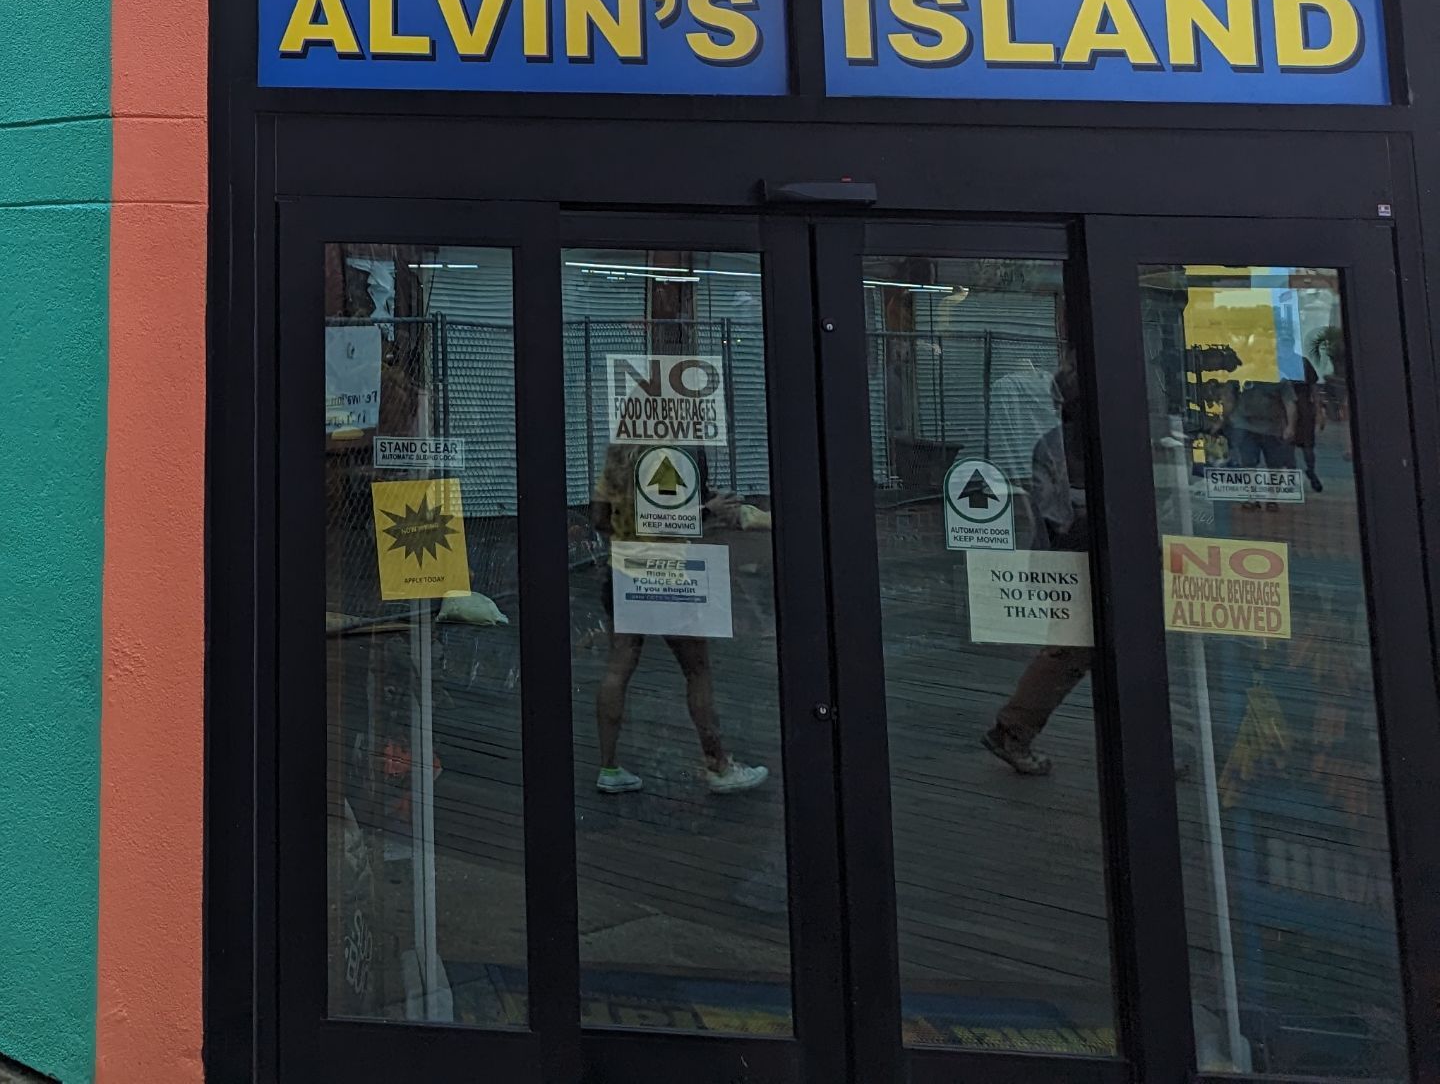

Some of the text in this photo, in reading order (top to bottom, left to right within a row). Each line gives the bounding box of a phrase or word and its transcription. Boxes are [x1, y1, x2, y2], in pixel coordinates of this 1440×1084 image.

[613, 359, 720, 398] NO
[614, 397, 717, 421] FOOD OR BEVERAGES
[616, 420, 719, 439] ALLOWED
[380, 441, 458, 454] STAND CLEAR
[1210, 472, 1295, 486] STAND CLEAR
[640, 513, 677, 521] AUTOMATIC
[665, 522, 696, 530] MOVING
[951, 526, 989, 534] AUTOMATIC
[977, 536, 1009, 544] MOVING
[646, 559, 686, 570] FREE
[1169, 542, 1285, 580] NO
[404, 575, 445, 584] APPLY TODAY
[632, 577, 698, 586] POLICE CAR
[990, 569, 1079, 585] NO DRINKS
[1000, 588, 1072, 602] NO FOOD
[1171, 575, 1281, 606] ALCOHOLIC BEVERAGES
[1004, 605, 1071, 620] THANKS
[1171, 600, 1282, 632] ALLOWED
